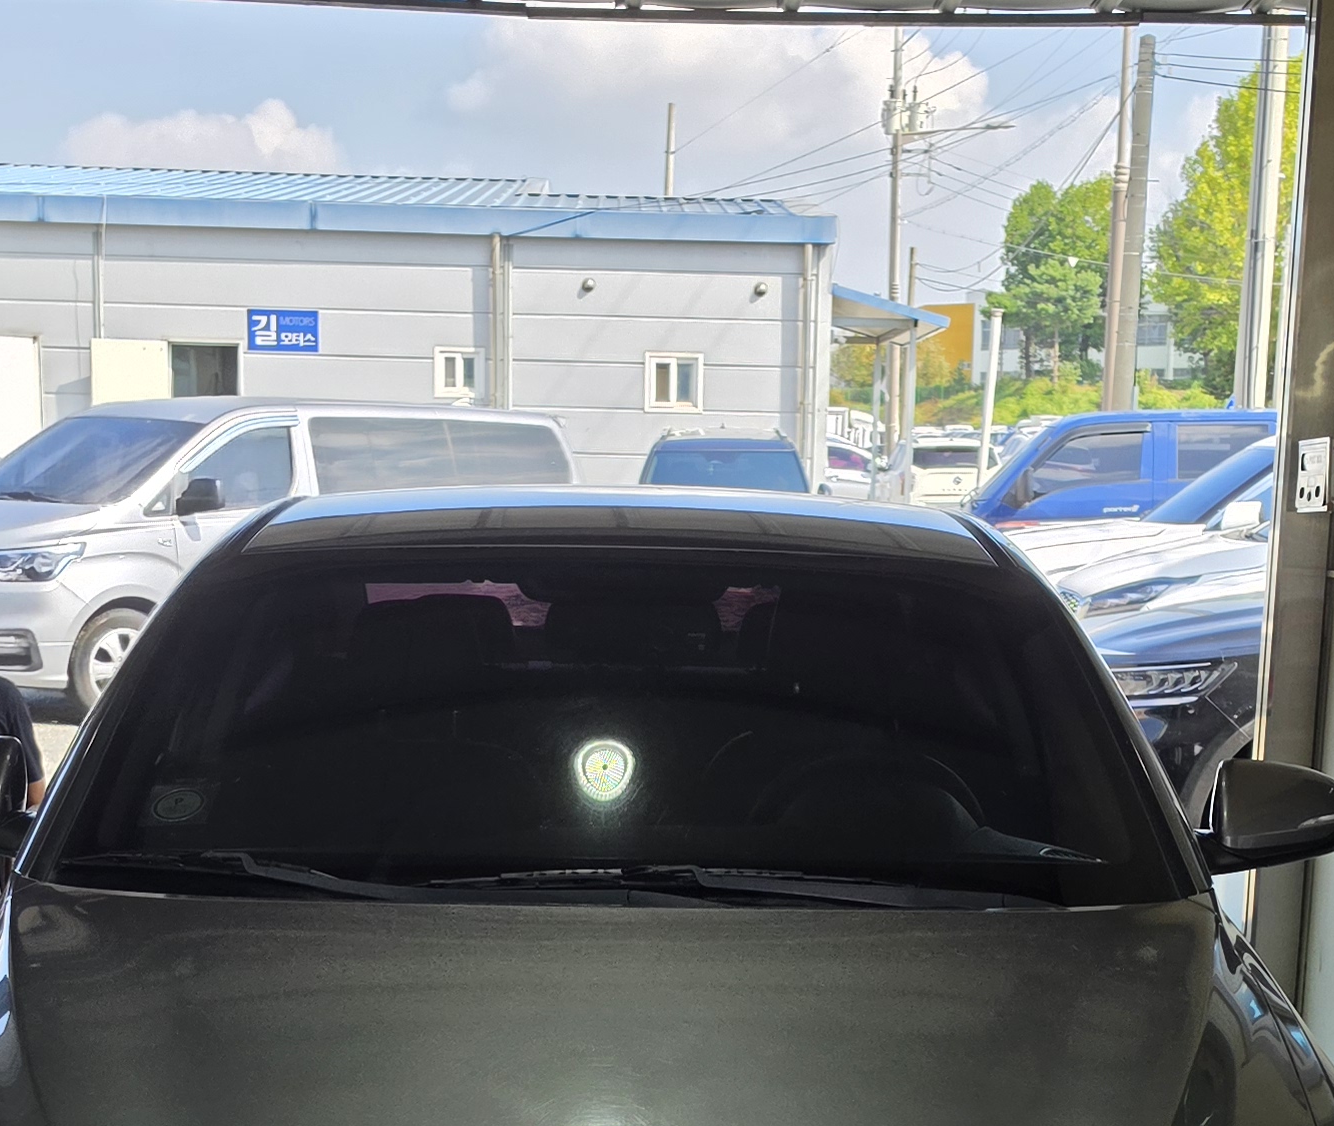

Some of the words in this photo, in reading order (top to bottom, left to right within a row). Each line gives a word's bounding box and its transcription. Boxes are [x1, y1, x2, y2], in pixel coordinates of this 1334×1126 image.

[279, 316, 316, 326] MOTORS
[251, 314, 278, 346] 길
[280, 332, 316, 347] 모터스
